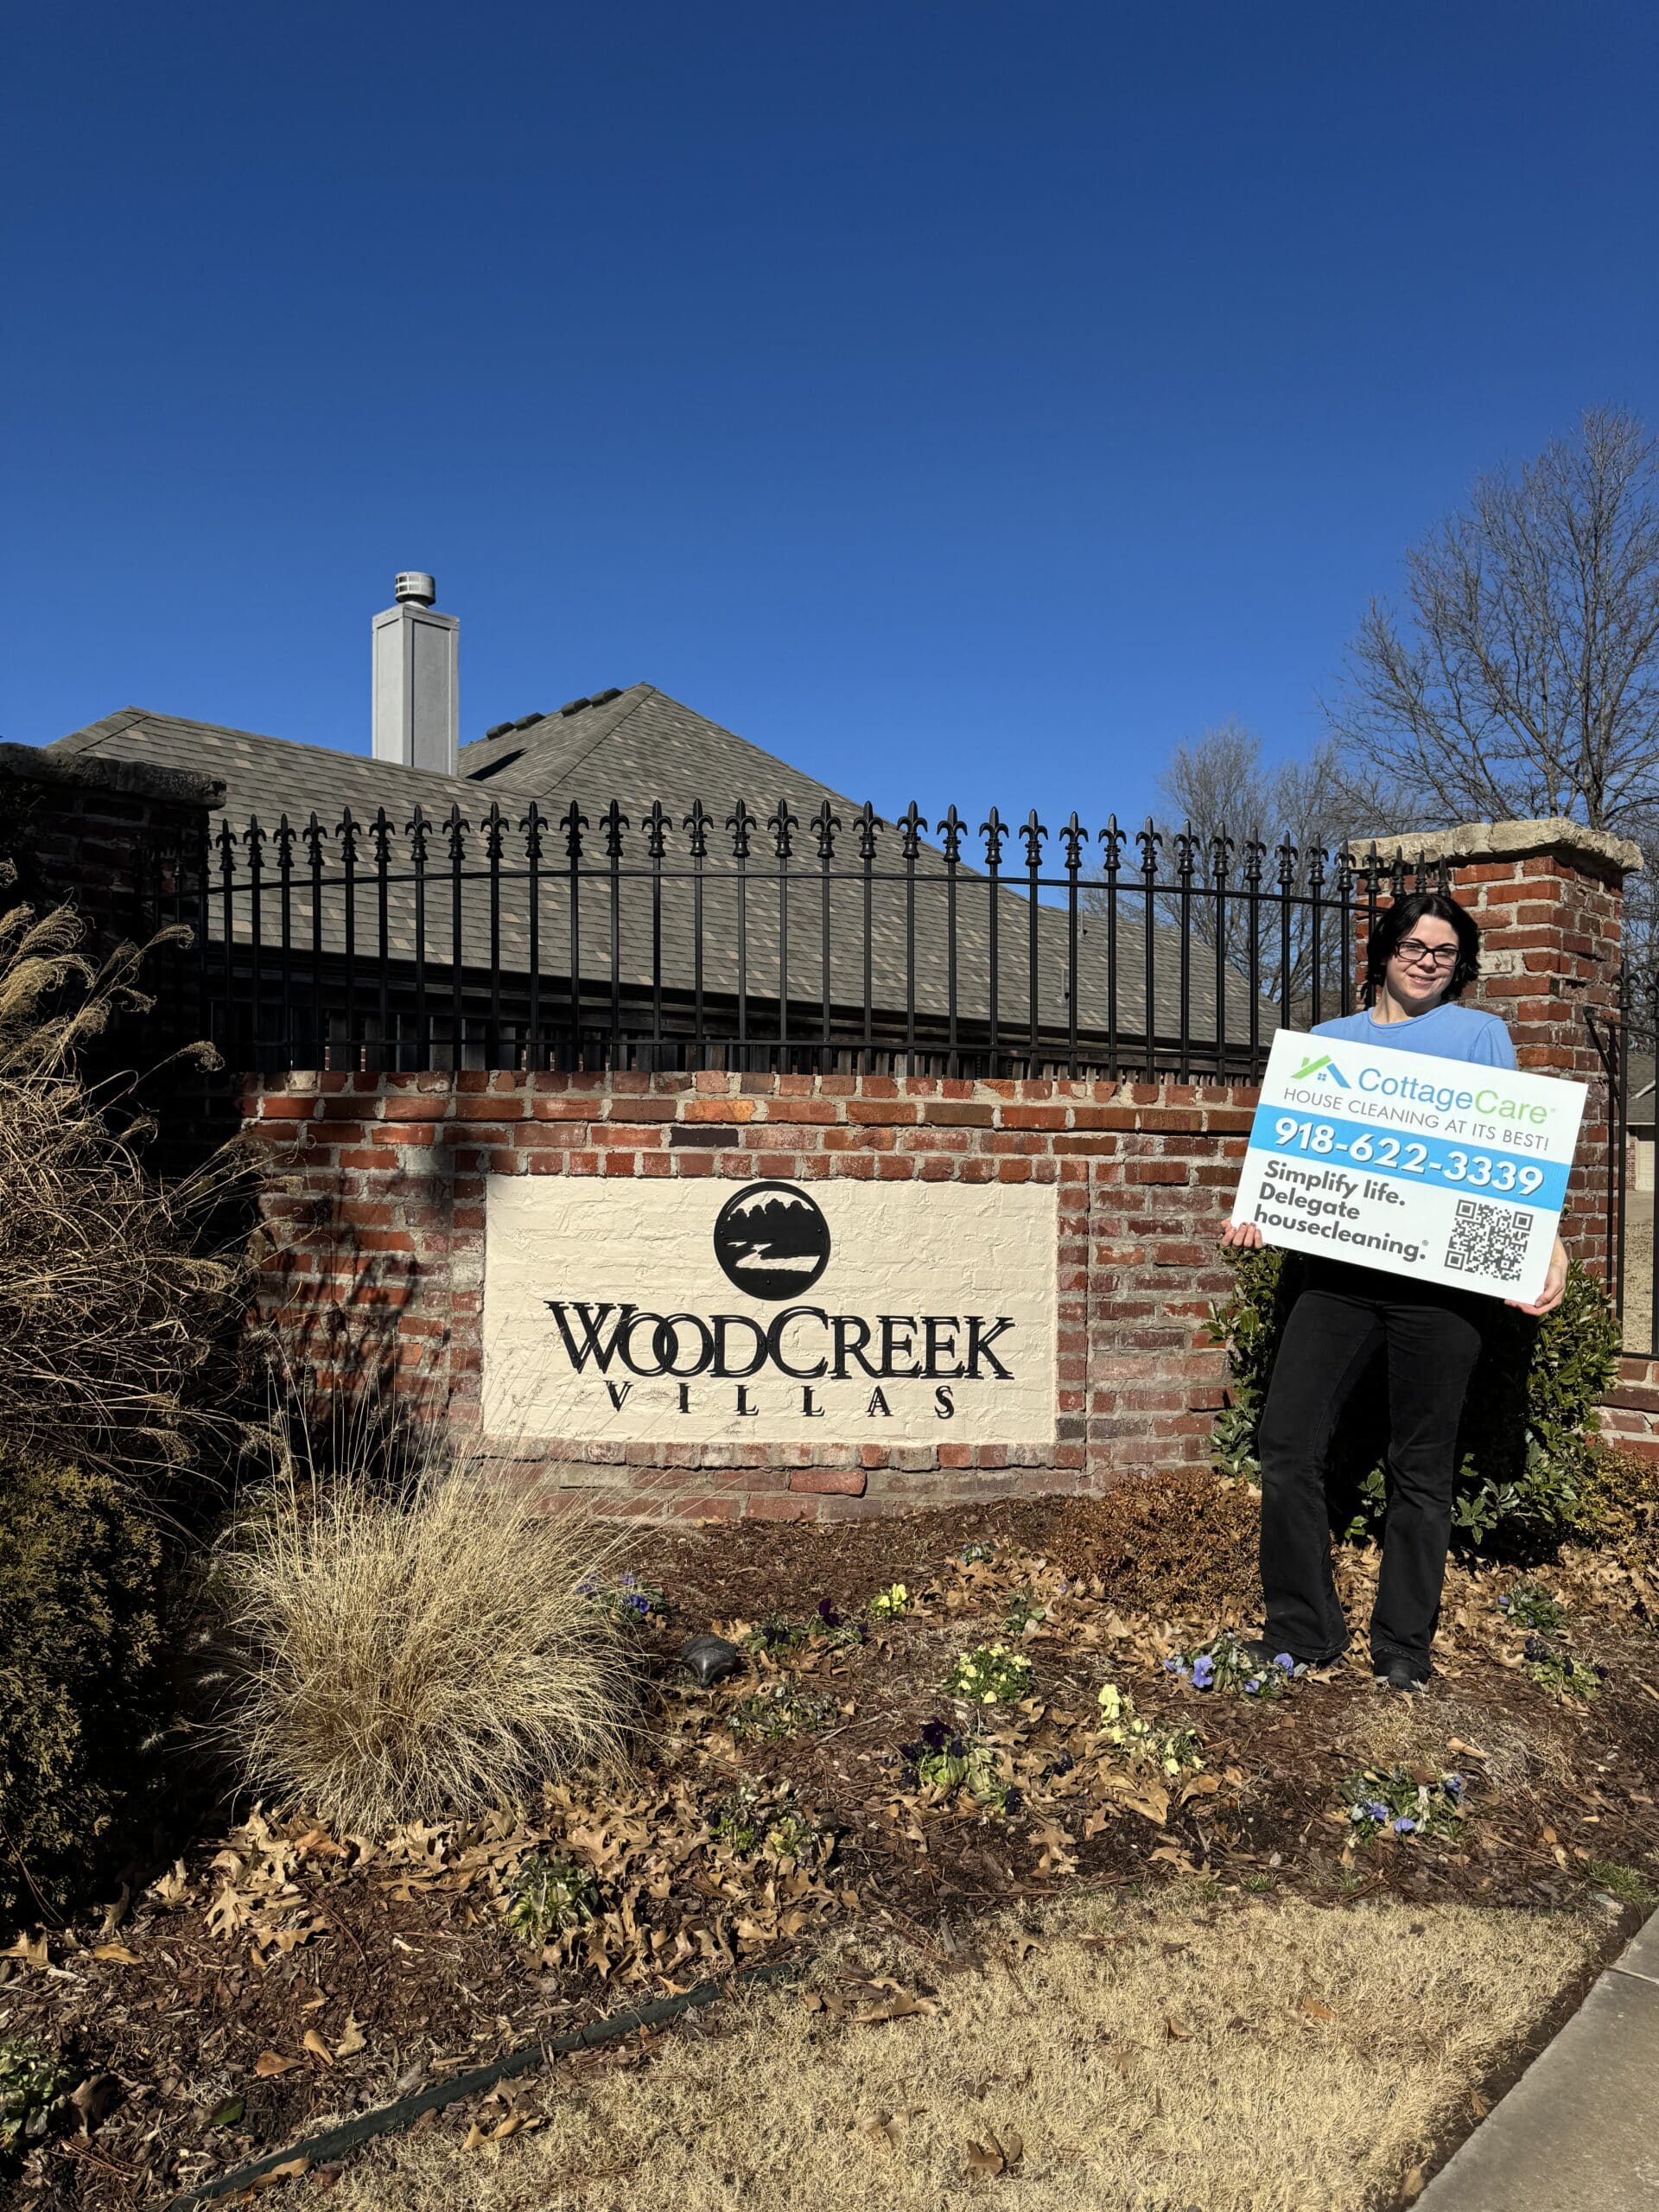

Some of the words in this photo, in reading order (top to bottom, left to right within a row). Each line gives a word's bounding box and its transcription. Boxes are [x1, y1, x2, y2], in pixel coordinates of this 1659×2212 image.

[1284, 1087, 1344, 1110] HOUSE
[1348, 1100, 1440, 1128] CLEANING
[1444, 1119, 1467, 1134] AT
[1471, 1123, 1497, 1140] ITS
[1503, 1129, 1549, 1151] BEST!
[1358, 1068, 1548, 1124] CottageCare
[1274, 1117, 1544, 1196] 918-622-3339
[1259, 1181, 1360, 1220] Delegate
[1264, 1160, 1359, 1199] Simplify
[1363, 1179, 1406, 1206] life.
[607, 1381, 954, 1419] VILLAS
